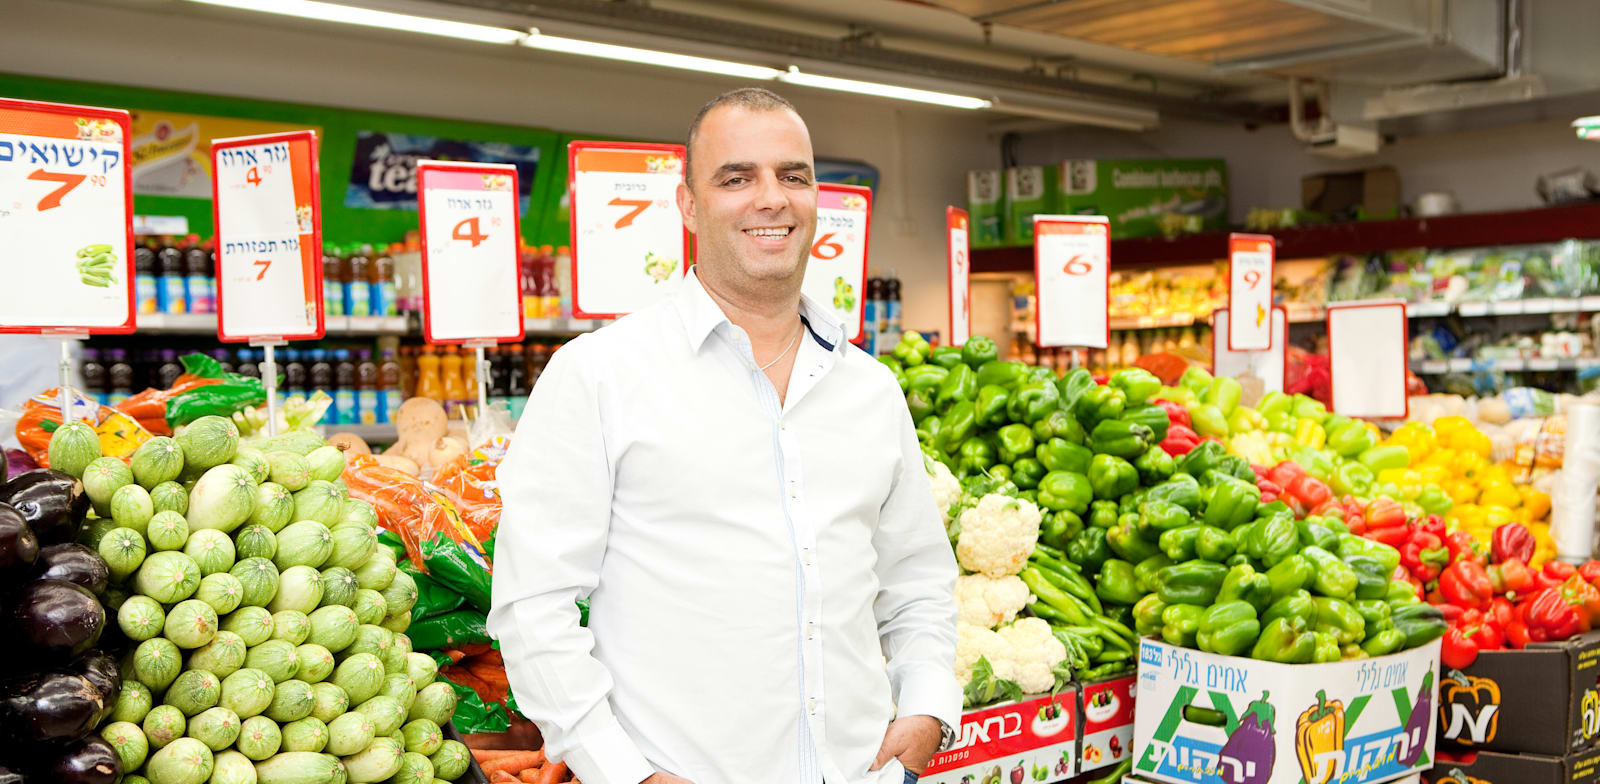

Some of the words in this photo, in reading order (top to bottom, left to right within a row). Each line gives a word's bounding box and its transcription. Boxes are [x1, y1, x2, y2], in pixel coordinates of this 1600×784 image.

[0, 141, 119, 174] קישואים
[264, 145, 287, 162] גזר
[26, 168, 88, 212] 7
[90, 175, 106, 187] 90
[246, 166, 262, 187] 4
[607, 197, 653, 230] 7
[452, 216, 490, 248] 4
[810, 232, 844, 260] 6
[253, 259, 272, 281] 7
[1063, 253, 1092, 276] 6
[1243, 269, 1262, 291] 9
[1167, 649, 1199, 685] גלילי
[1207, 663, 1248, 693] אחים
[1357, 661, 1382, 692] גלילי
[1384, 661, 1408, 688] אחים
[1148, 738, 1256, 783] ירקות
[1310, 726, 1421, 784] ירקות
